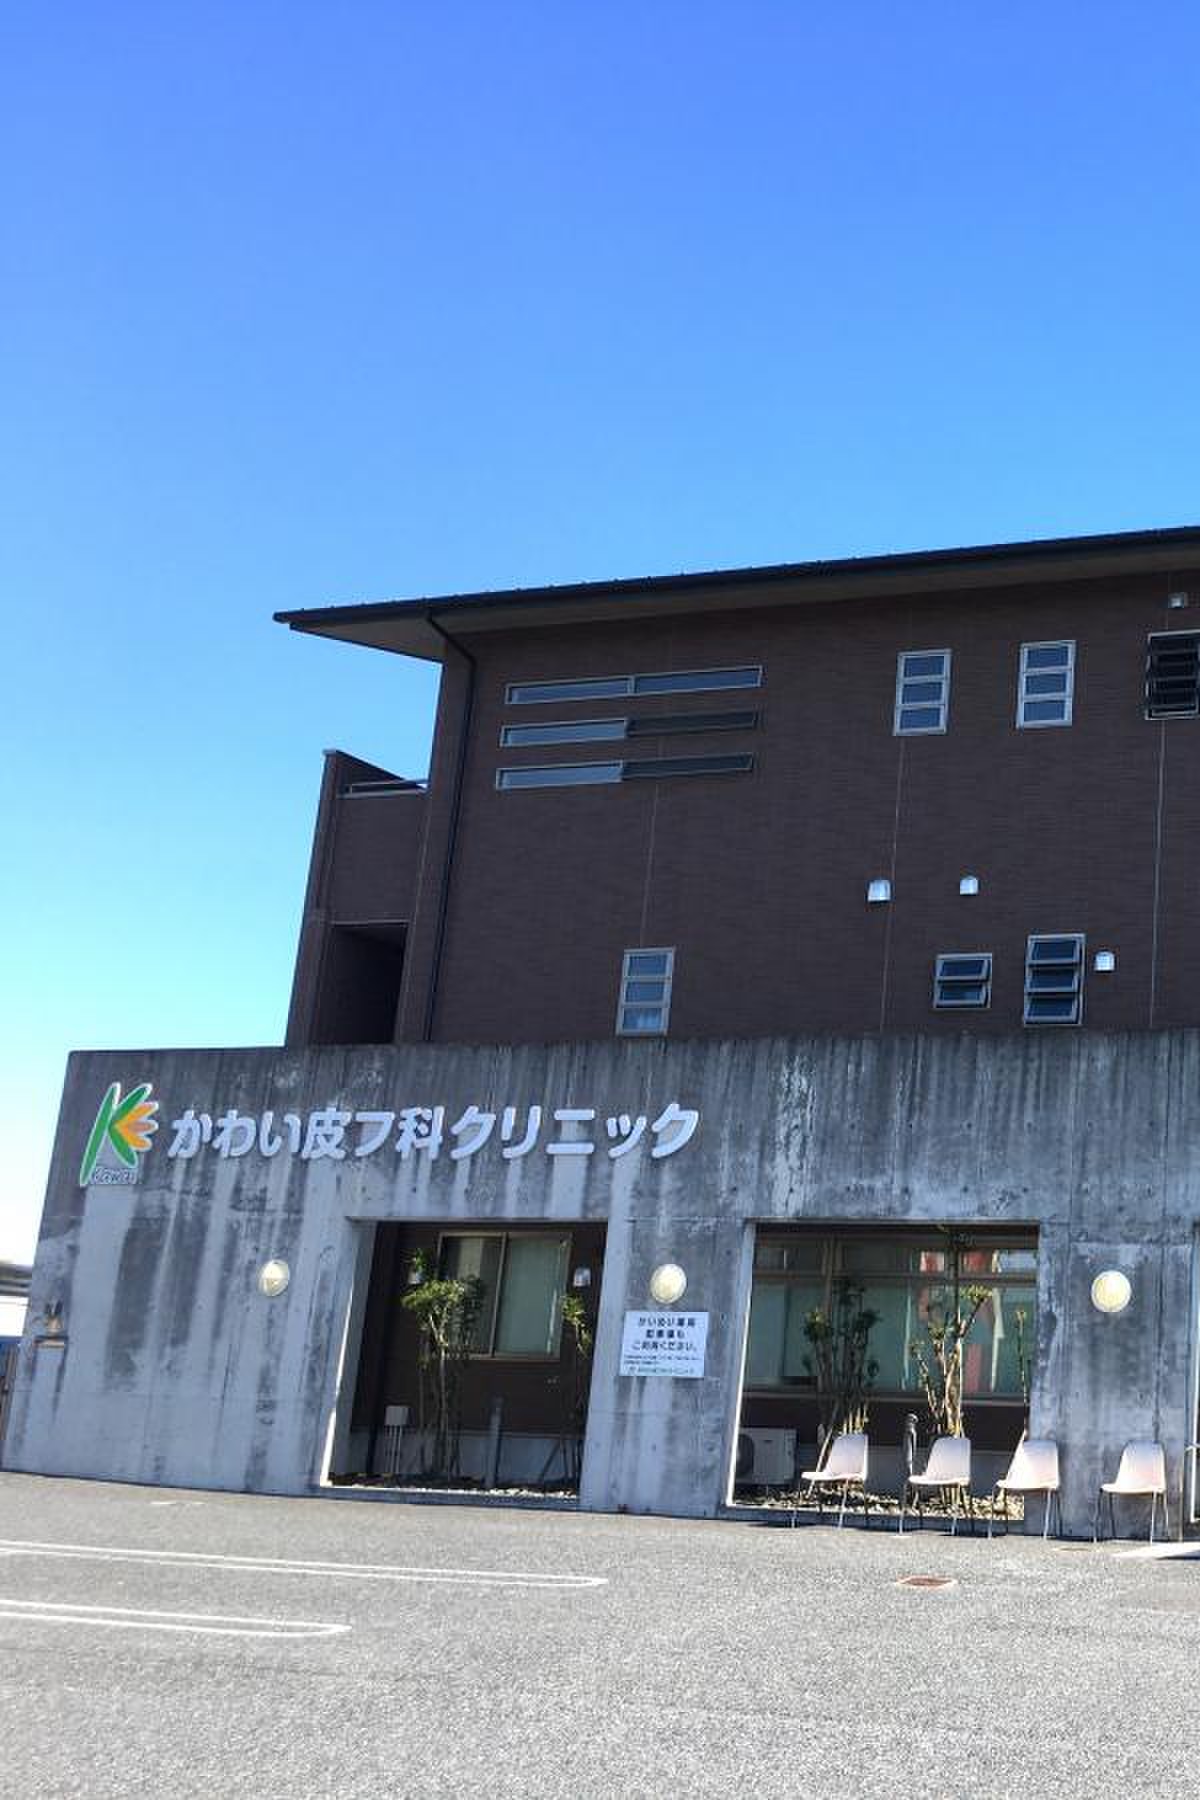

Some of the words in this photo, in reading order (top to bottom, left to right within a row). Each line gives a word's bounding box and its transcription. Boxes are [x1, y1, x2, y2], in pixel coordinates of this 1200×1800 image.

[167, 1102, 700, 1160] かわい皮フ科クリニック
